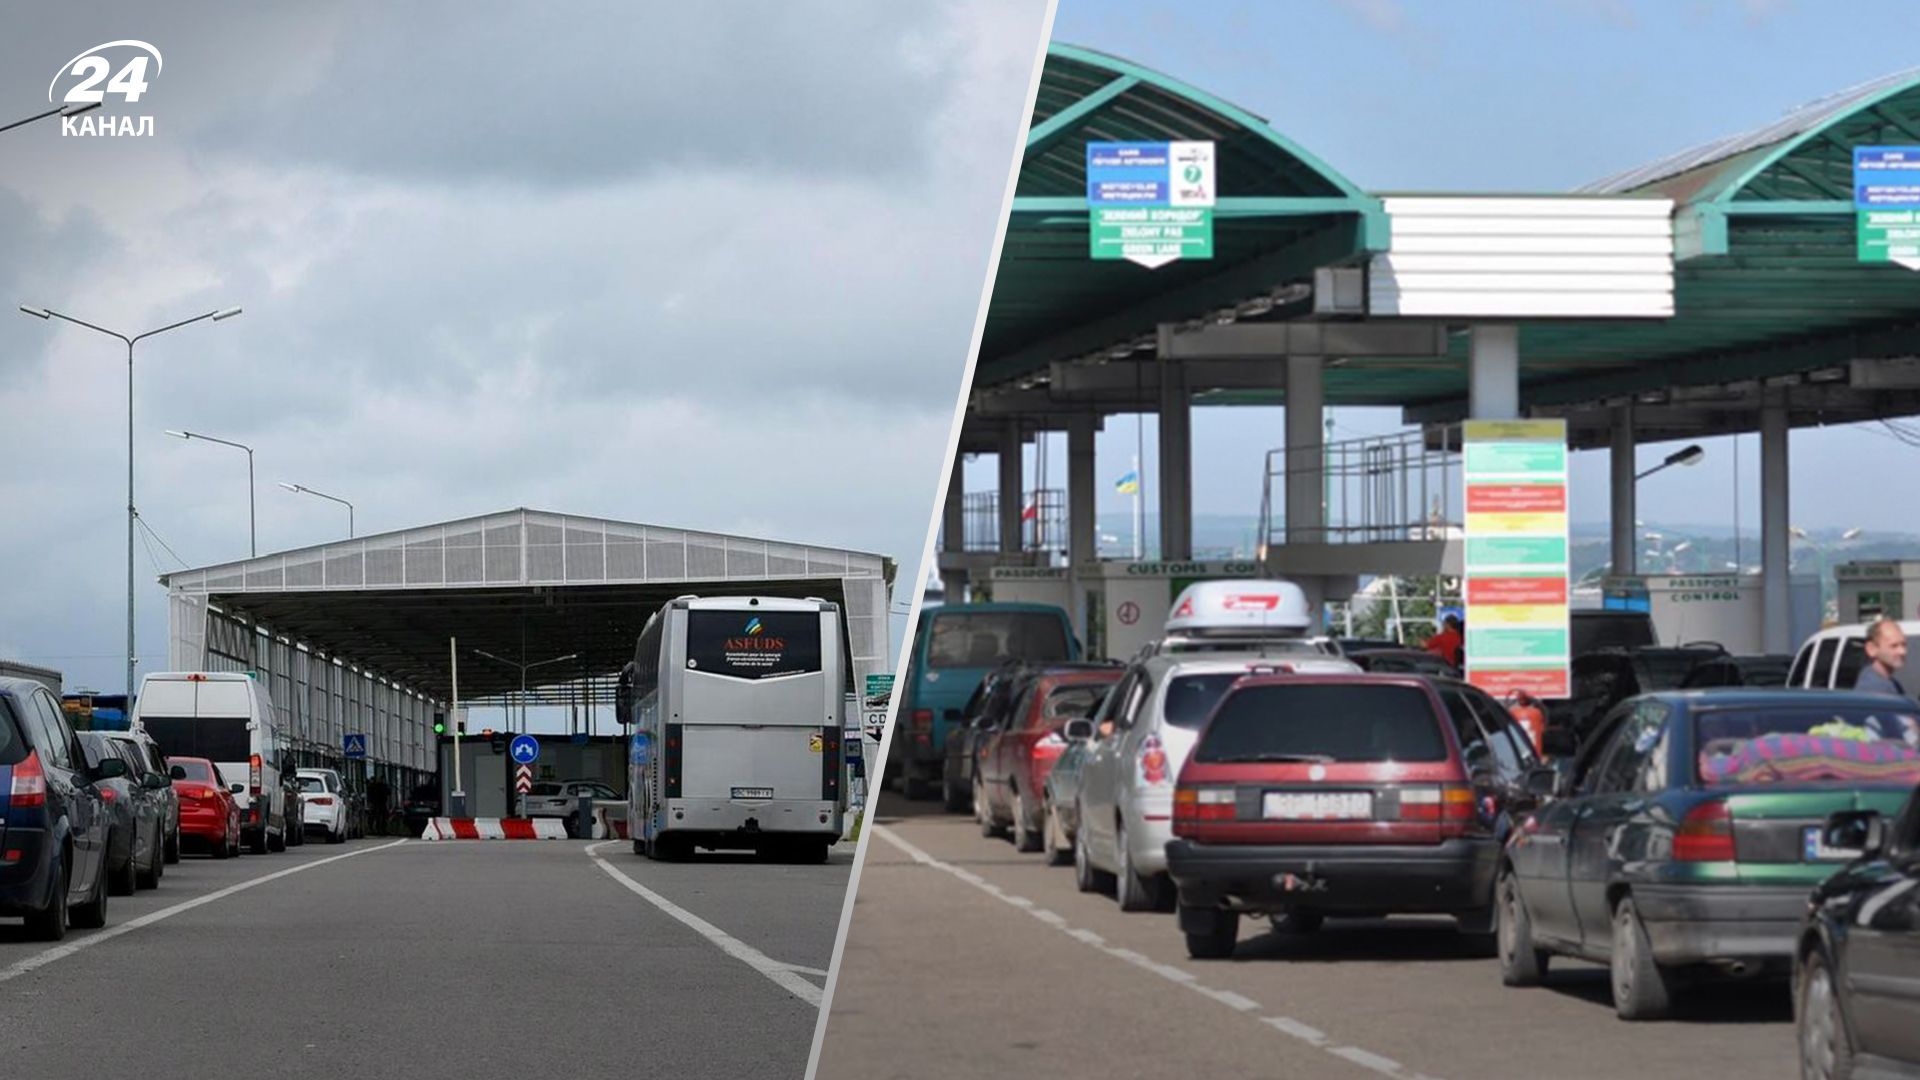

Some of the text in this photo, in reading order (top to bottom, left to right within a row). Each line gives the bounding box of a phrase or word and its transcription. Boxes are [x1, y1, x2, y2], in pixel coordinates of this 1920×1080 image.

[1156, 243, 1183, 255] LANE
[994, 568, 1064, 579] PASSPORT
[1127, 563, 1207, 575] CUSTOMS
[1669, 579, 1740, 588] PASSPORT
[1671, 591, 1741, 602] CONTROL
[868, 713, 887, 725] CD
